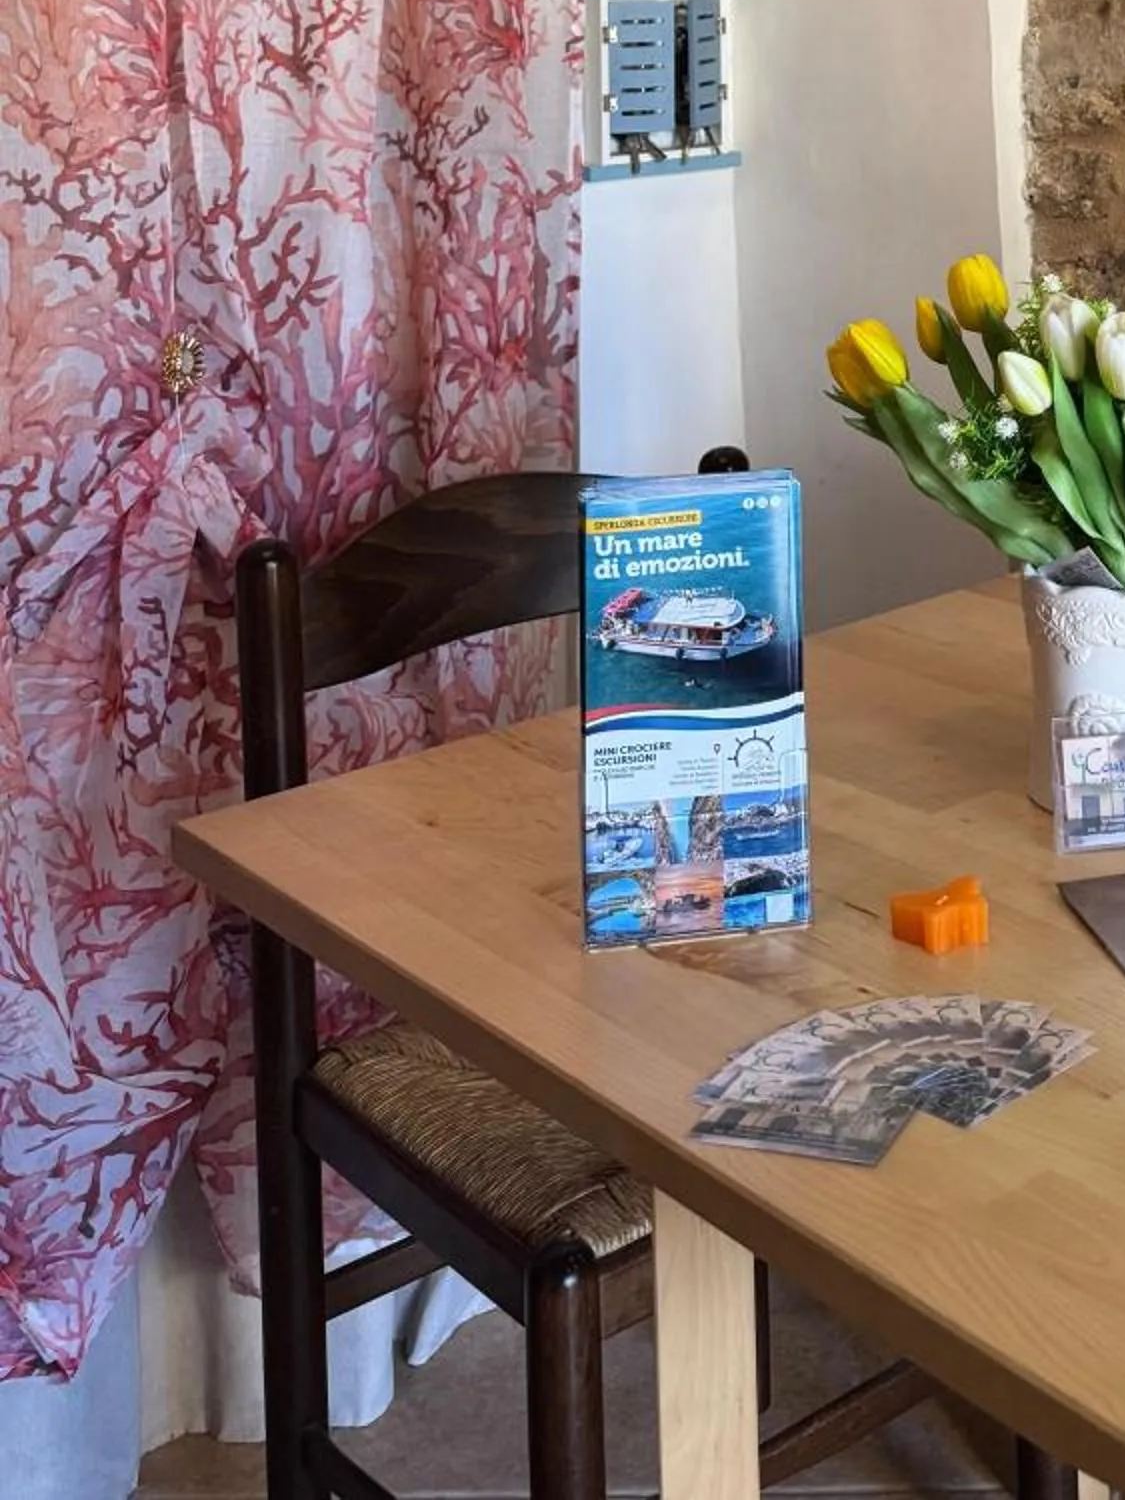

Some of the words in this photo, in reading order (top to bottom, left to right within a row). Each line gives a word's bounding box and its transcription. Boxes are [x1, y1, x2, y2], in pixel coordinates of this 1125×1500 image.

[594, 536, 632, 556] Un
[638, 531, 703, 552] mare
[594, 559, 620, 580] di
[625, 547, 750, 578] emozioni.
[593, 747, 618, 757] MINI
